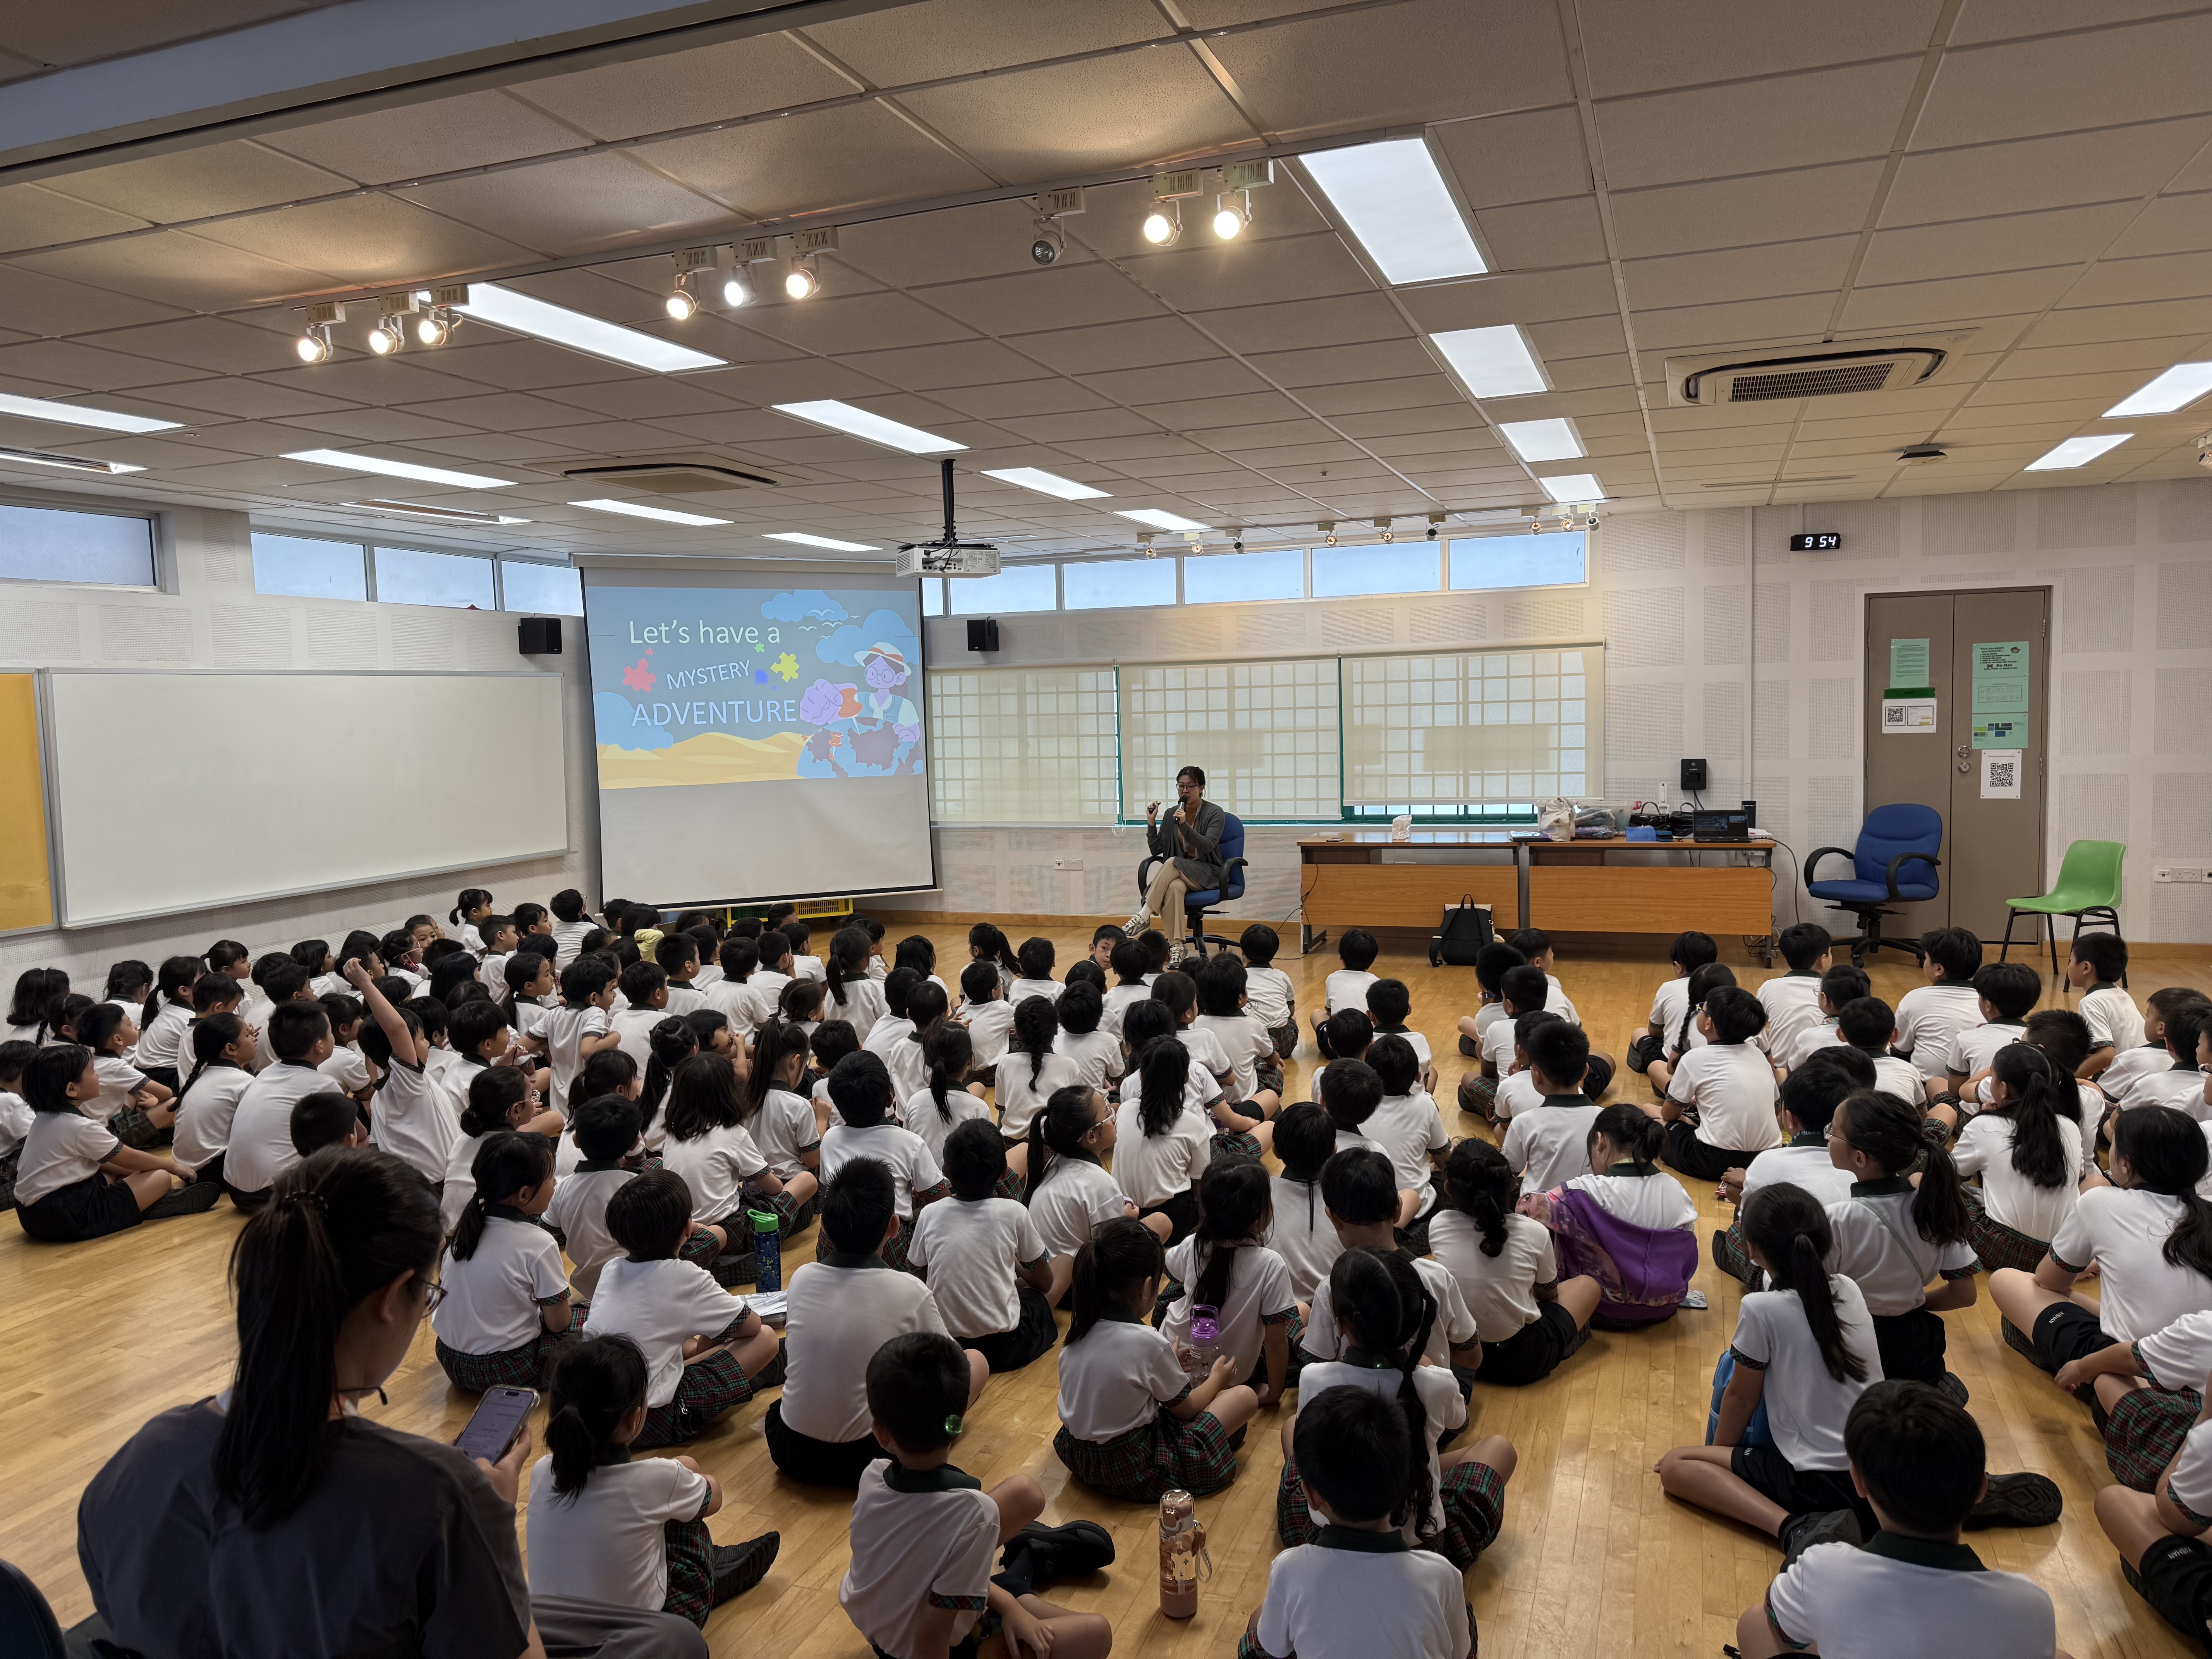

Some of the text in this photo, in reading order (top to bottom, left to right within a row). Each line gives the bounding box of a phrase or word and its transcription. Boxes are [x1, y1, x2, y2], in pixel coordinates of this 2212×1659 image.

[1805, 536, 1836, 548] 9 54
[630, 620, 780, 644] Let’s have a
[667, 660, 750, 690] MYSTERY
[632, 700, 797, 726] ADVENTURE
